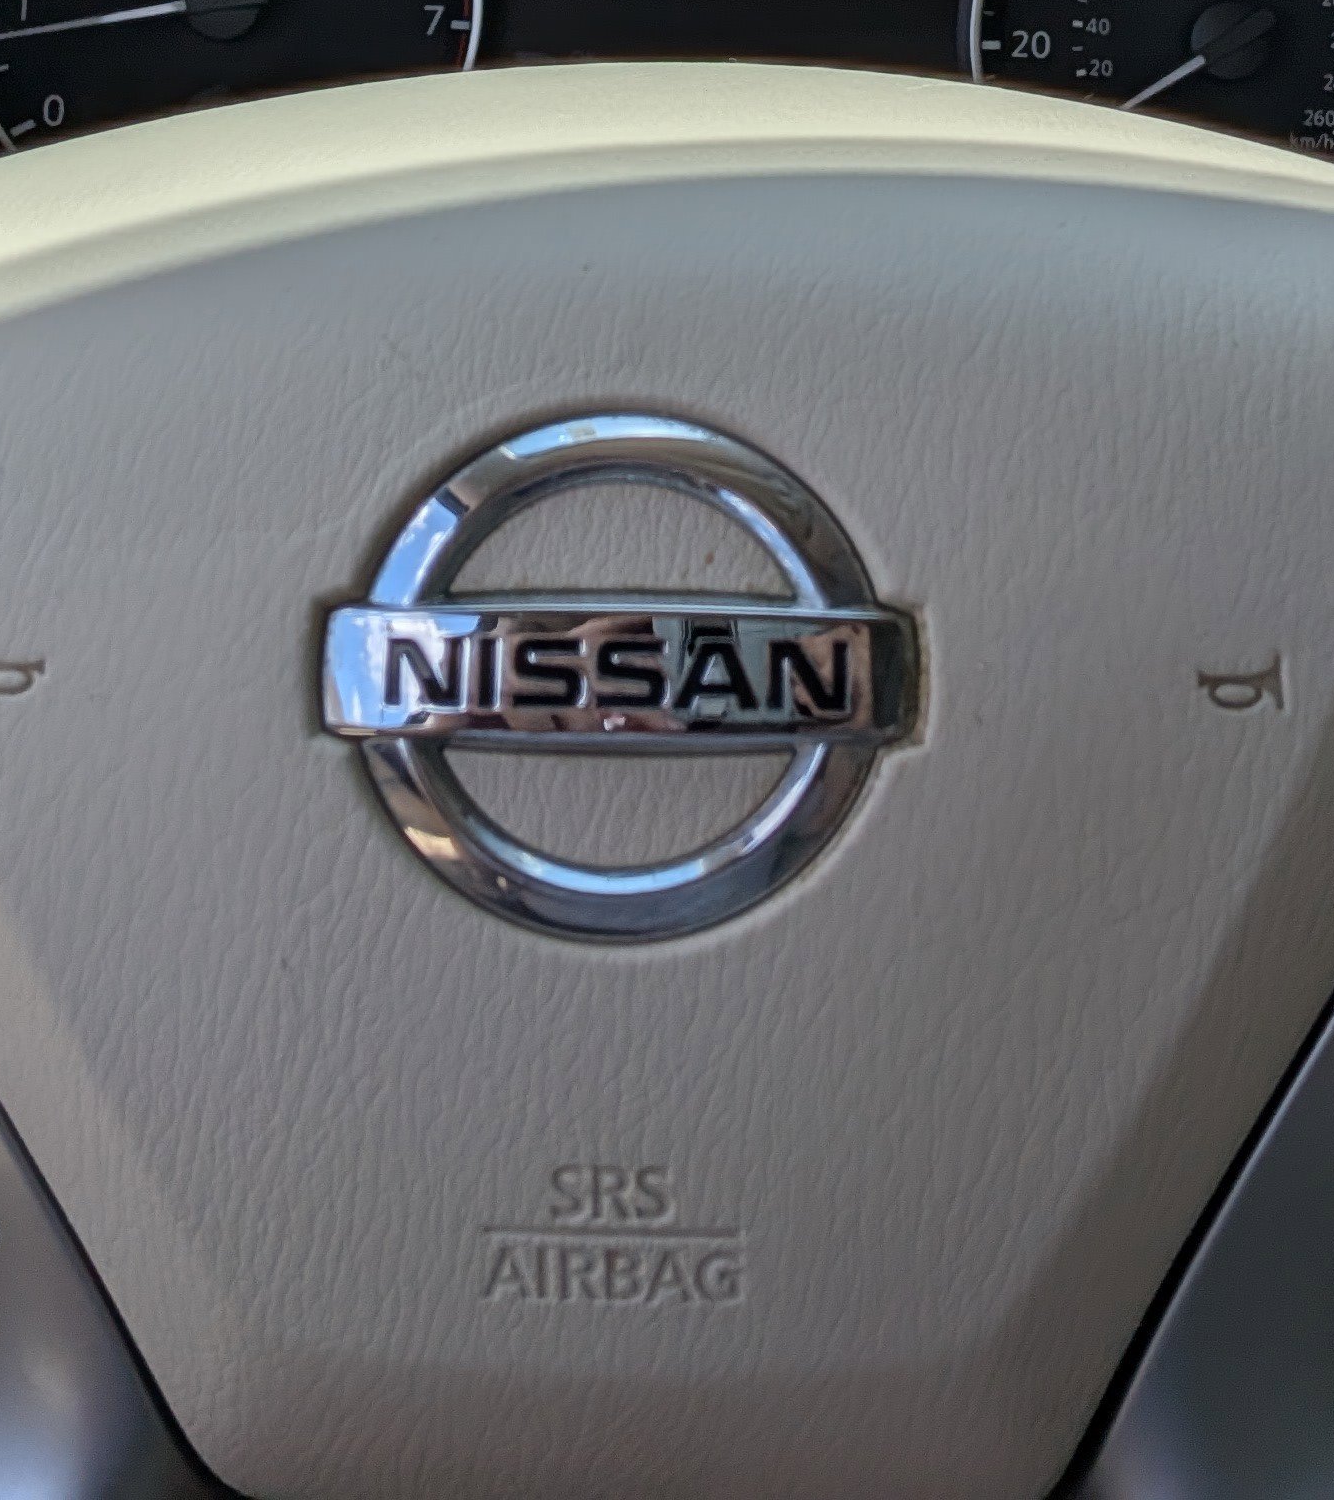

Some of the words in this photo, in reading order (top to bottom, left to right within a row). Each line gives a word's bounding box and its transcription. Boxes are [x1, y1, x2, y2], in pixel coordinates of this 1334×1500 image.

[423, 4, 445, 36] 7
[1085, 17, 1111, 36] 40
[1011, 29, 1051, 59] 20
[1089, 58, 1113, 77] 20
[42, 94, 65, 127] 0
[383, 636, 851, 712] NISSAN
[549, 1162, 670, 1222] SRS
[479, 1245, 743, 1305] AIRBAG
